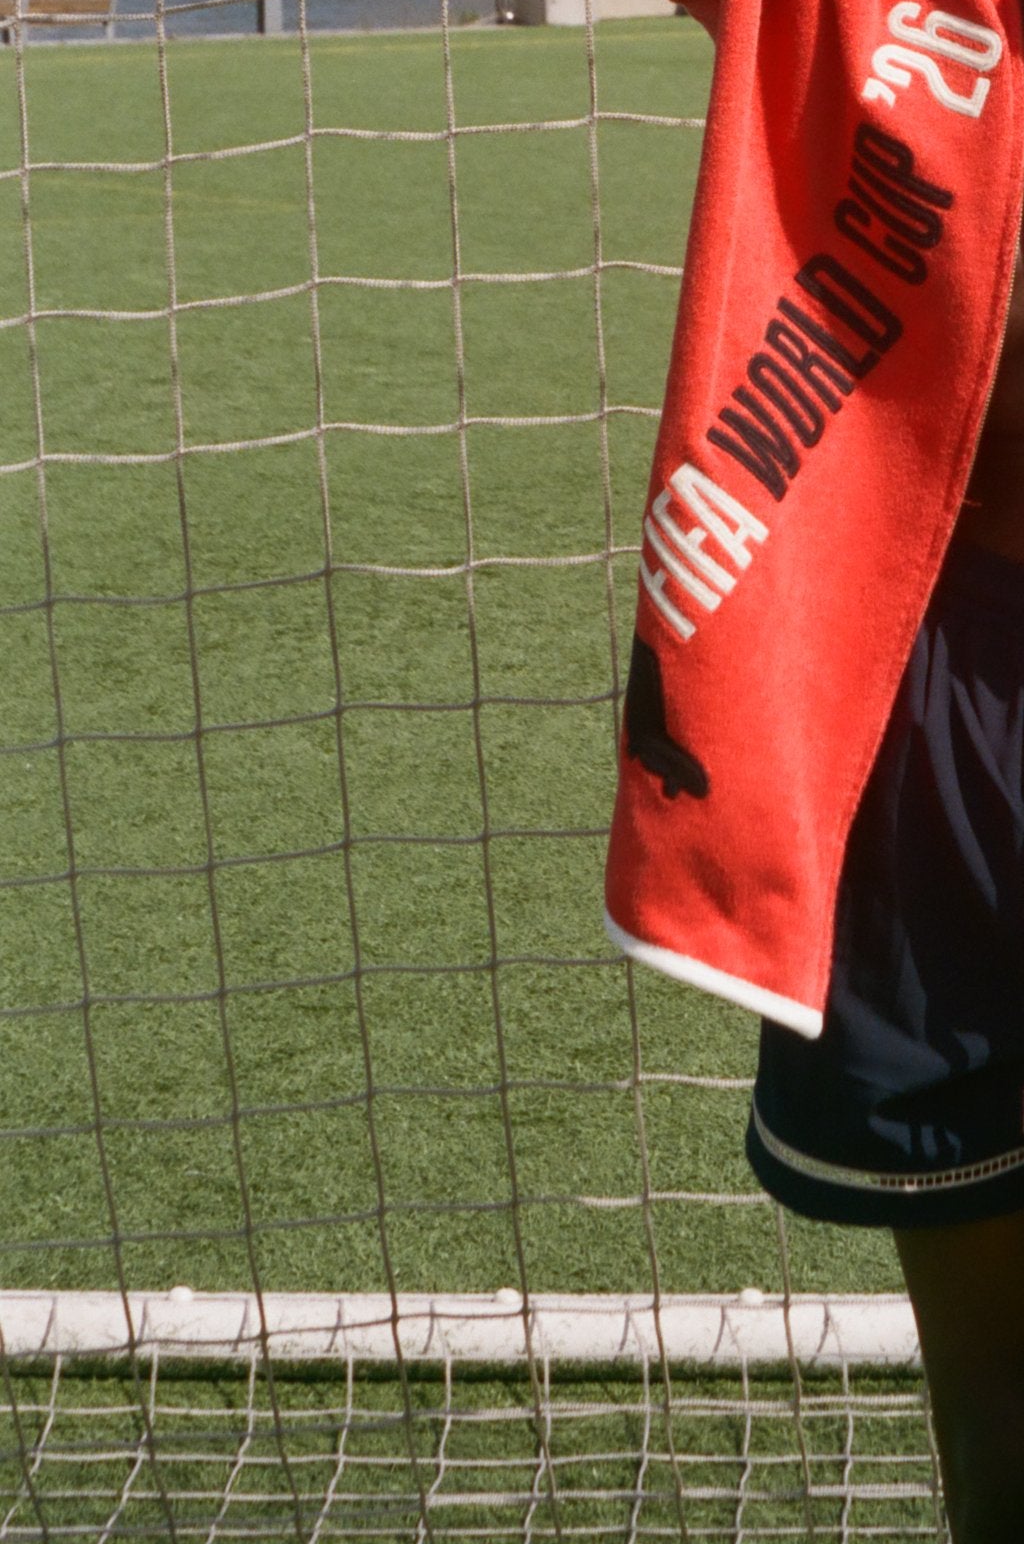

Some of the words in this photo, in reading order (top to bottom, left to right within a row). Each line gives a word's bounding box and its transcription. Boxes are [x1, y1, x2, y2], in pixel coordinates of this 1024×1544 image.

[640, 462, 770, 641] FIFA
[706, 253, 904, 503] WORLD
[833, 121, 955, 286] CUP
